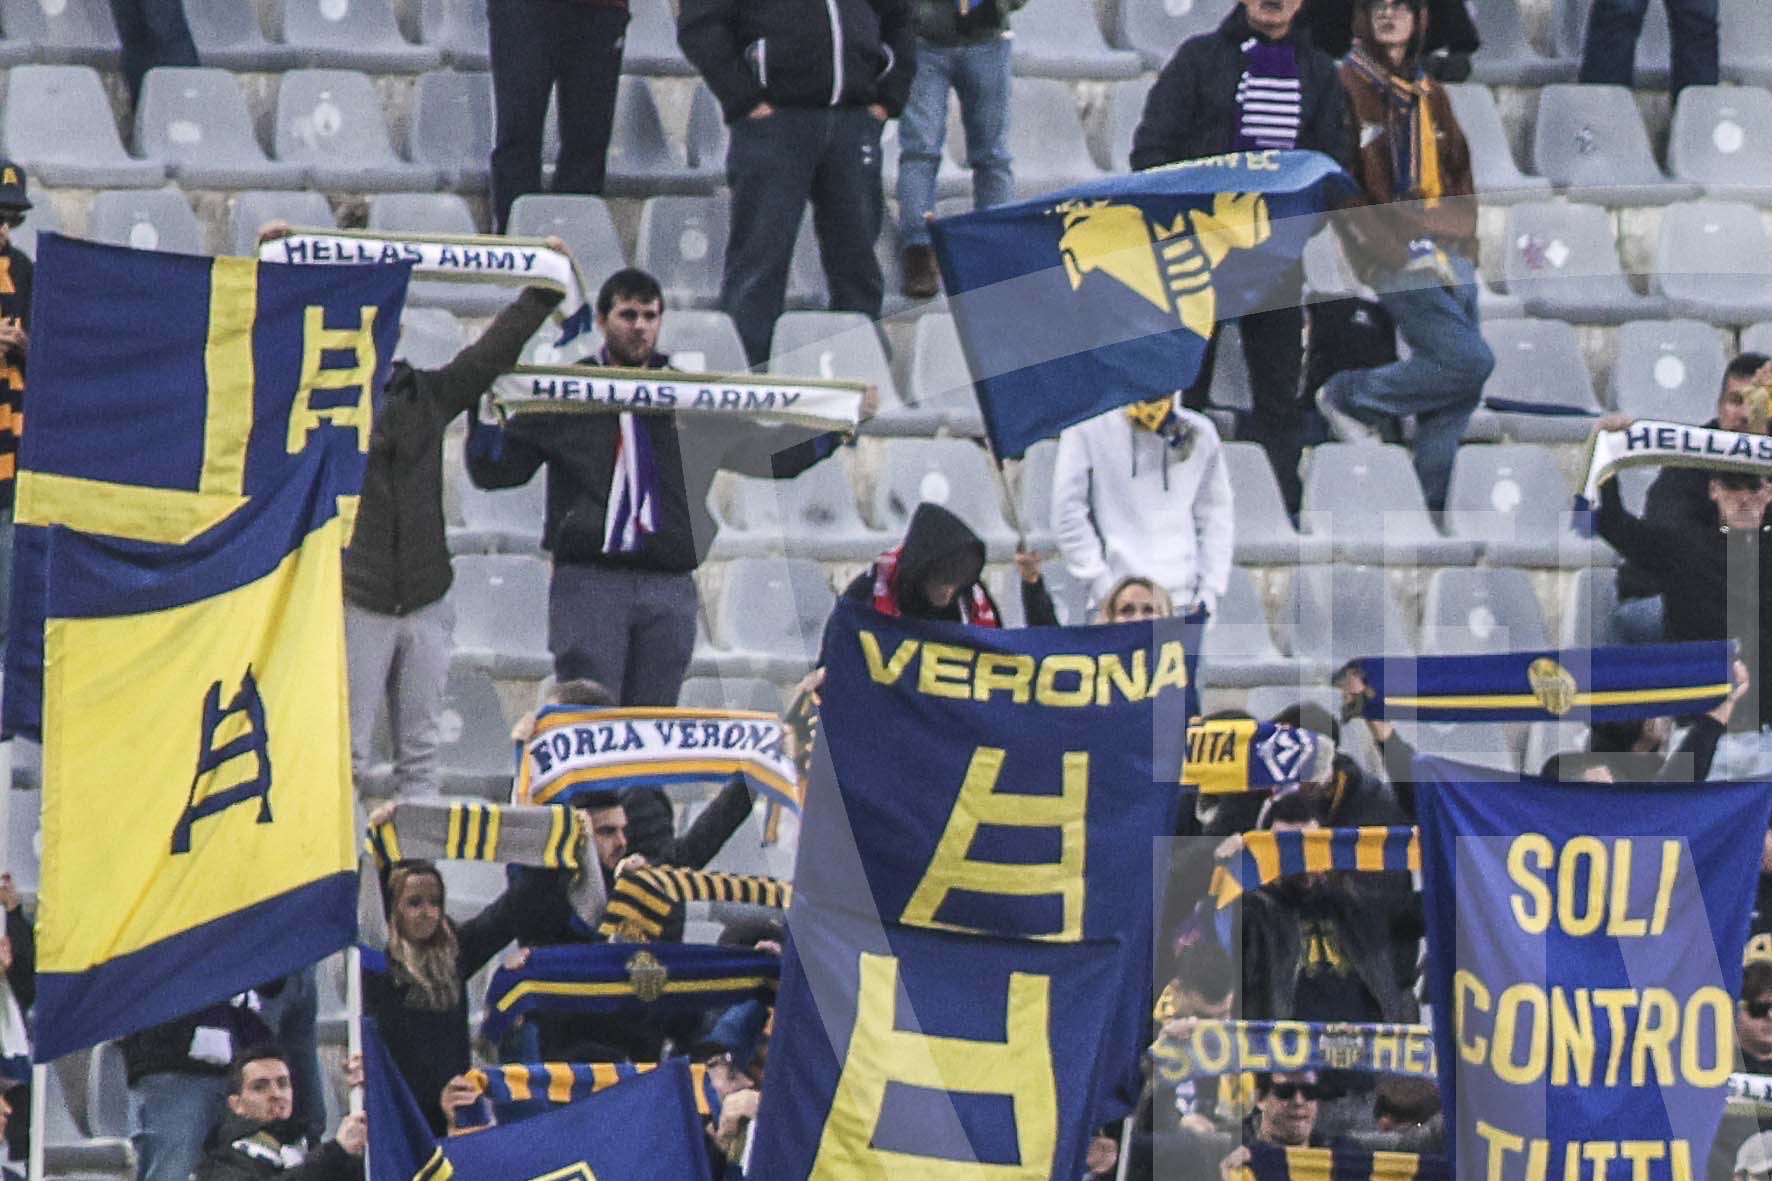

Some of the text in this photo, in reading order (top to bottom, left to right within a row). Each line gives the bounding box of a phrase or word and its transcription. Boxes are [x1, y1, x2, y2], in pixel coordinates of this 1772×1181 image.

[284, 239, 538, 271] HELLAS ARMY
[531, 379, 802, 409] HELLAS ARMY
[858, 629, 1188, 707] VERONA
[529, 720, 788, 774] FORZA VERONA
[1505, 832, 1682, 937] SOLI
[1151, 1020, 1312, 1082] SOLO
[1453, 967, 1735, 1089] CONTRO
